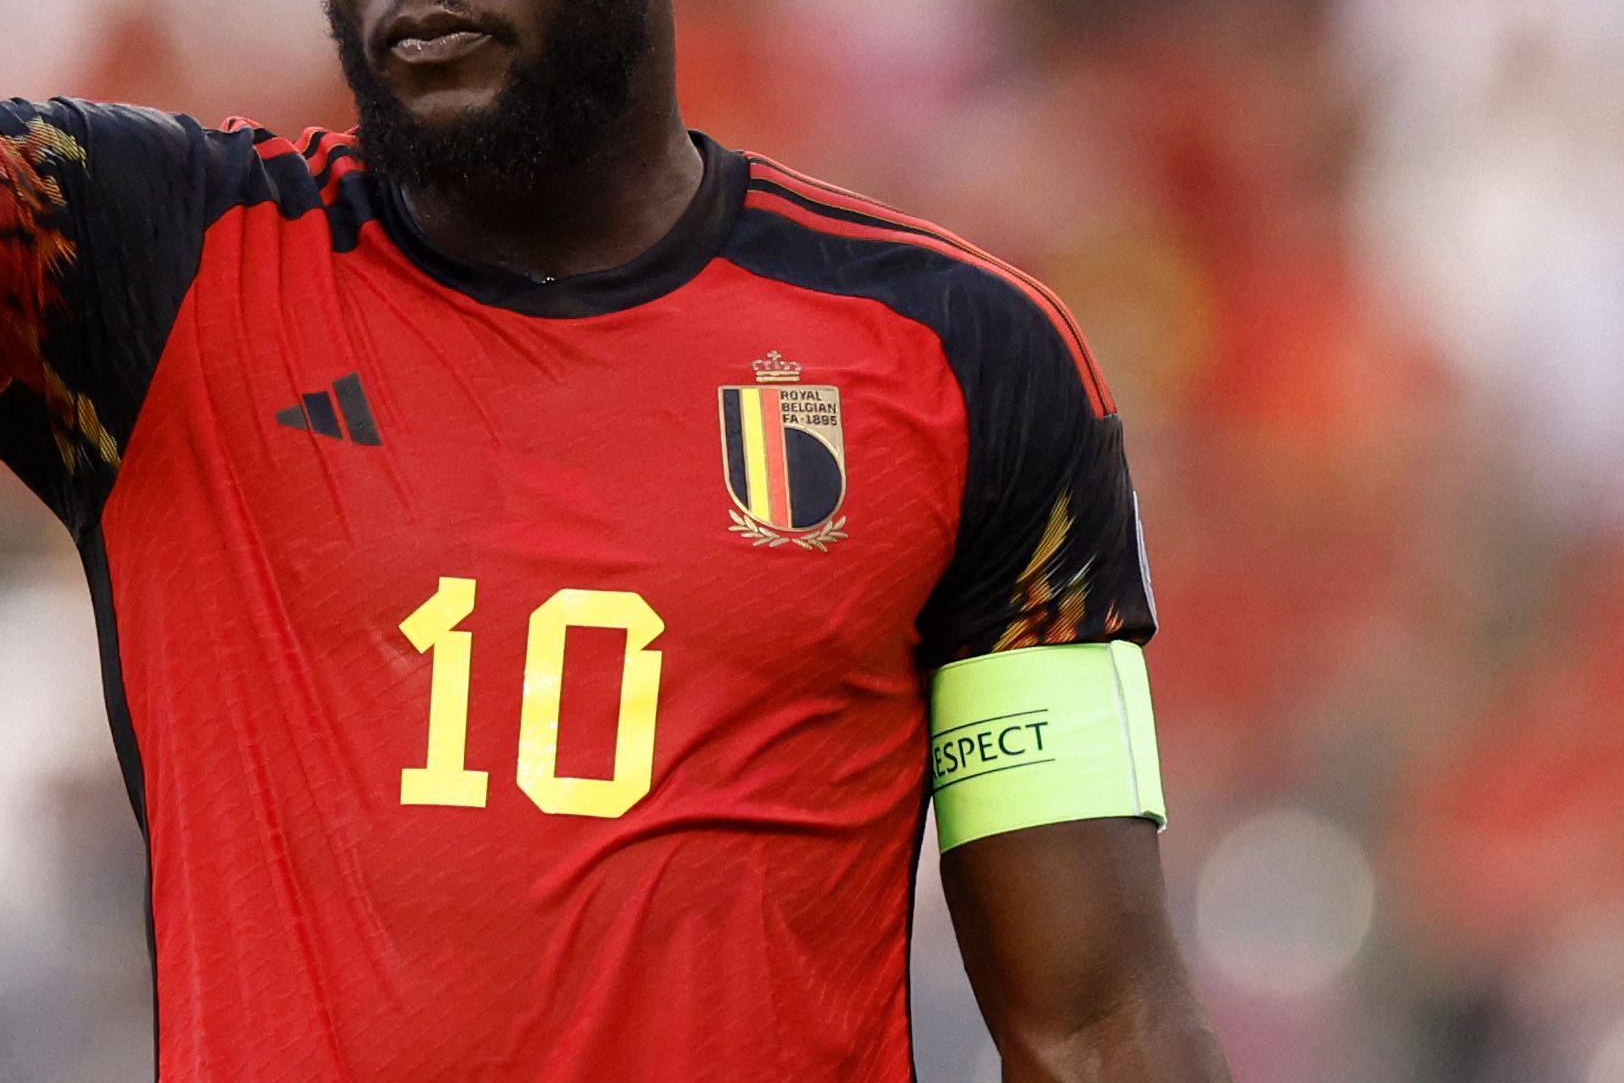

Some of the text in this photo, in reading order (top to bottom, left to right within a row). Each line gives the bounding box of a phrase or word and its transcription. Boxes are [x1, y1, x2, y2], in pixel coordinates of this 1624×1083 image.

[781, 390, 822, 401] ROYAL
[781, 402, 837, 414] BELGIAN
[398, 576, 665, 819] 10
[932, 721, 1049, 778] ESPECT
